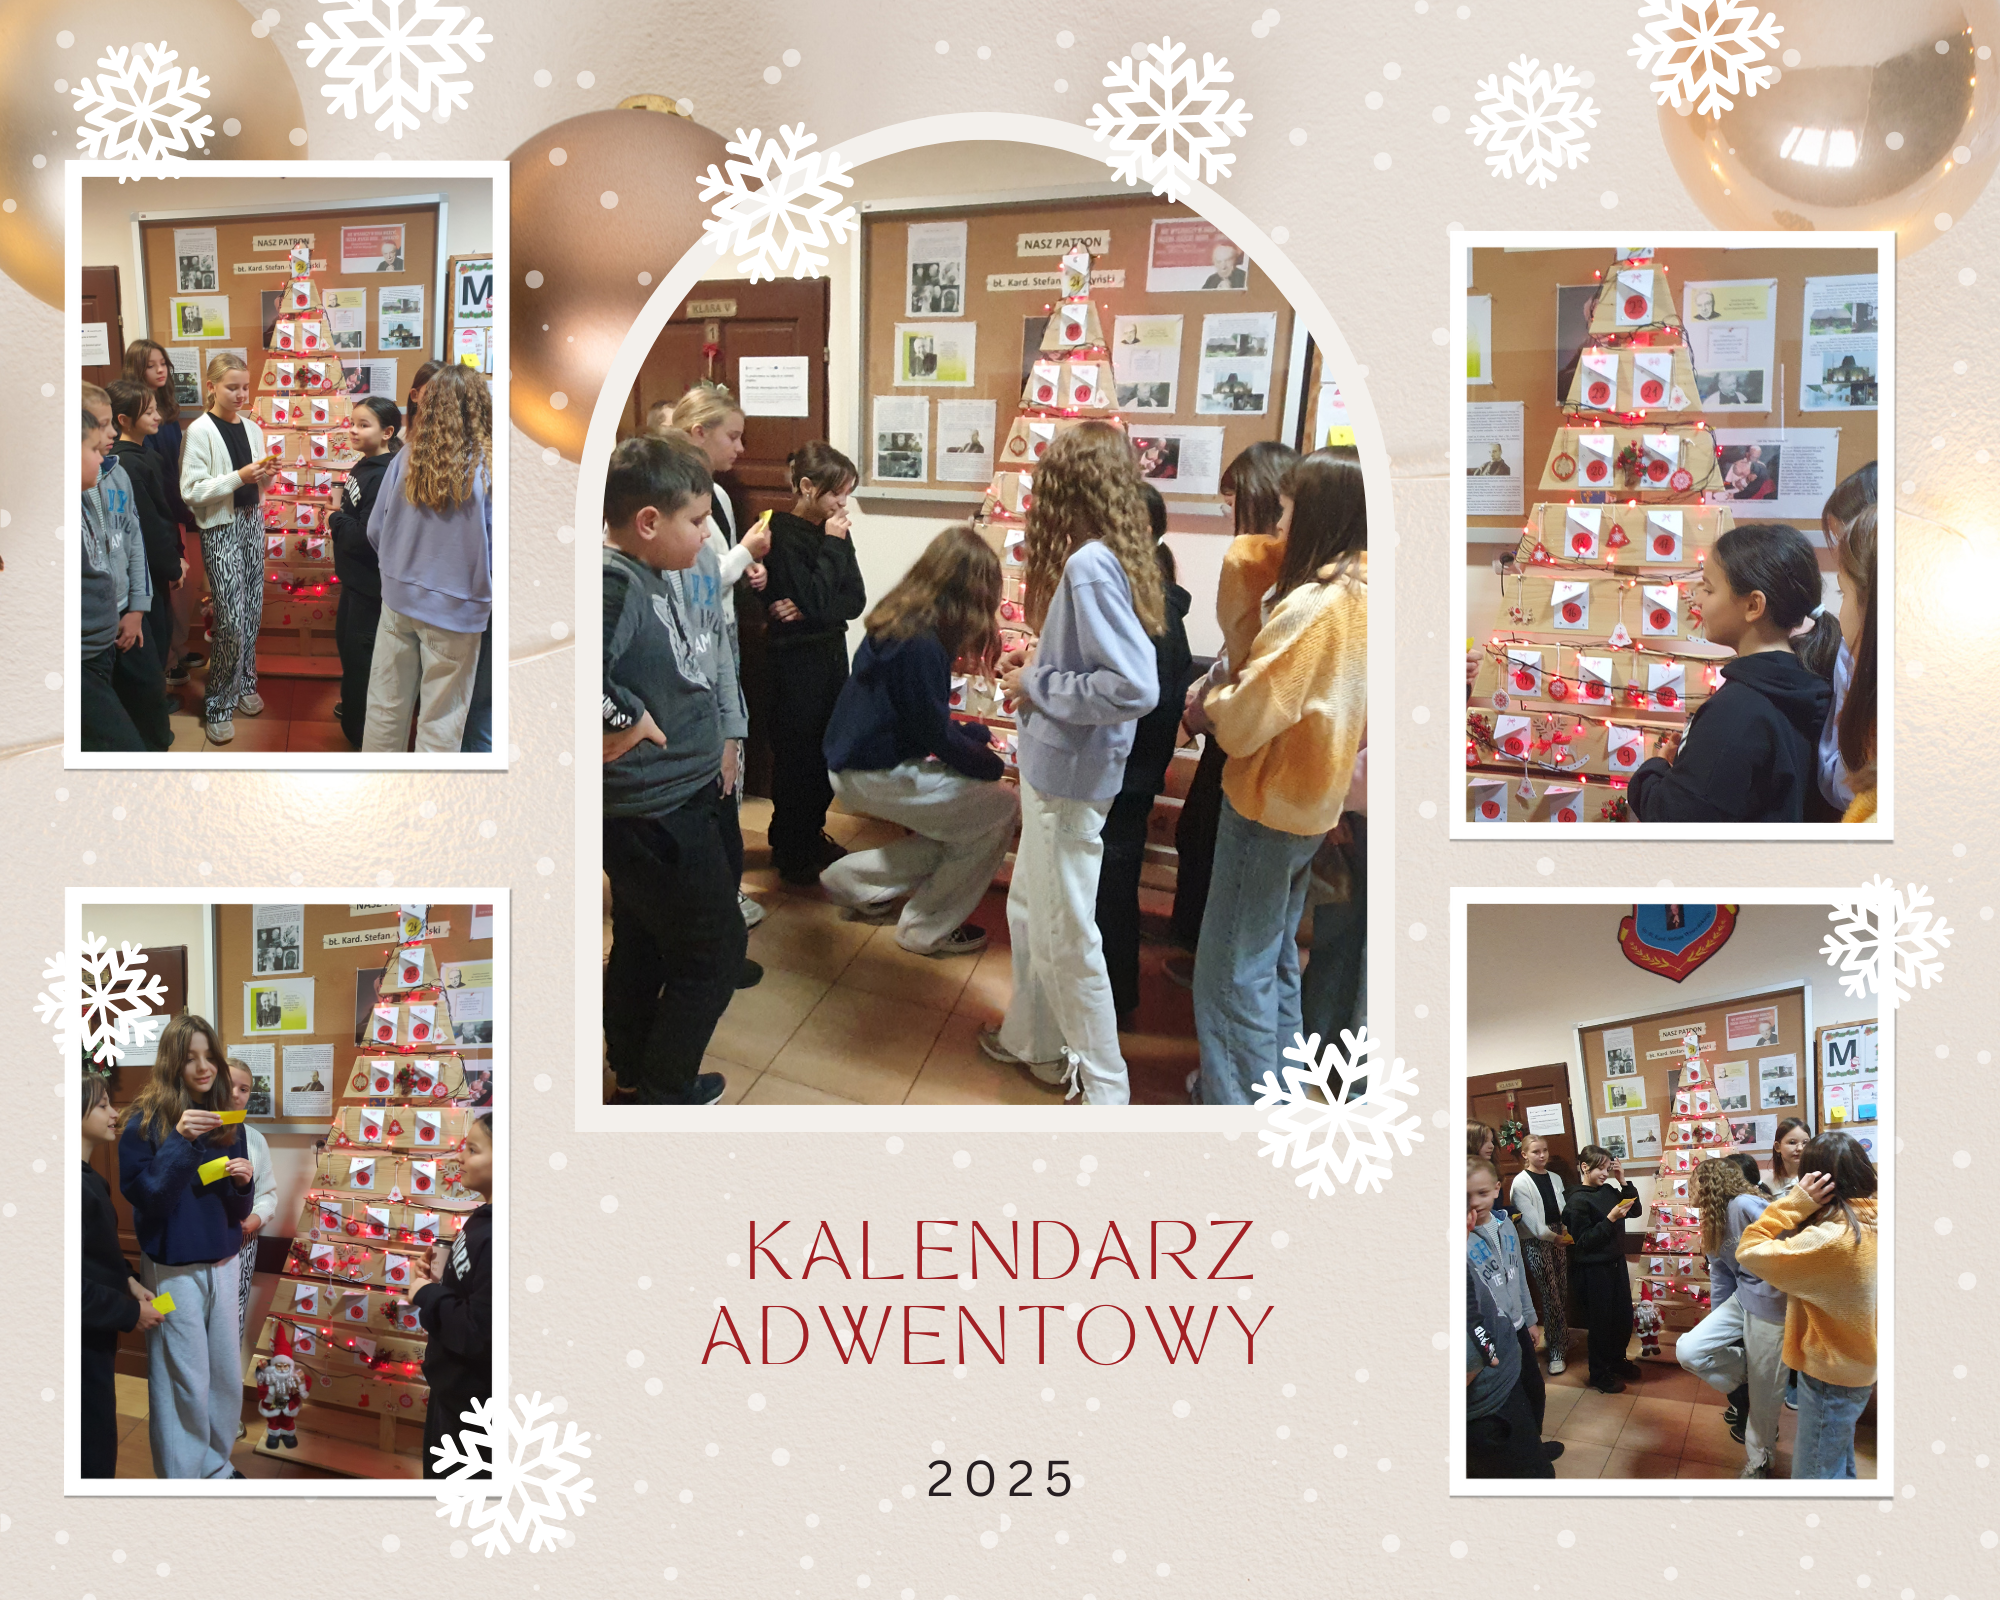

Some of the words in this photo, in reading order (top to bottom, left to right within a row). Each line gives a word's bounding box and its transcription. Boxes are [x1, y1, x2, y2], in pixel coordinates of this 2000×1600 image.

[258, 239, 278, 247] NASZ
[1024, 239, 1052, 250] NASZ
[248, 264, 265, 272] Kard.
[265, 263, 285, 271] Stefan
[993, 279, 1006, 288] bł.
[1008, 278, 1030, 287] Kard.
[1033, 276, 1062, 287] Stefan
[462, 275, 493, 306] M
[692, 303, 722, 314] KLASA
[724, 303, 731, 313] V
[1629, 299, 1643, 314] 23
[709, 327, 715, 339] 1
[1592, 387, 1606, 399] 22
[1645, 386, 1658, 398] 21
[1590, 465, 1604, 476] 20
[1566, 606, 1577, 618] 16
[1509, 741, 1520, 751] 10
[1622, 749, 1630, 763] 9
[1488, 804, 1495, 815] 7
[1563, 811, 1570, 822] 6
[328, 937, 340, 946] bł.
[342, 934, 362, 945] Kard.
[364, 932, 391, 942] Stefan
[406, 968, 417, 980] 23
[380, 1029, 390, 1038] 22
[416, 1027, 425, 1036] 21
[1662, 1029, 1678, 1038] NASZ
[1829, 1039, 1857, 1067] M
[378, 1081, 388, 1089] 20
[394, 1269, 400, 1279] 9
[354, 1307, 360, 1316] 6
[407, 1315, 414, 1325] 5
